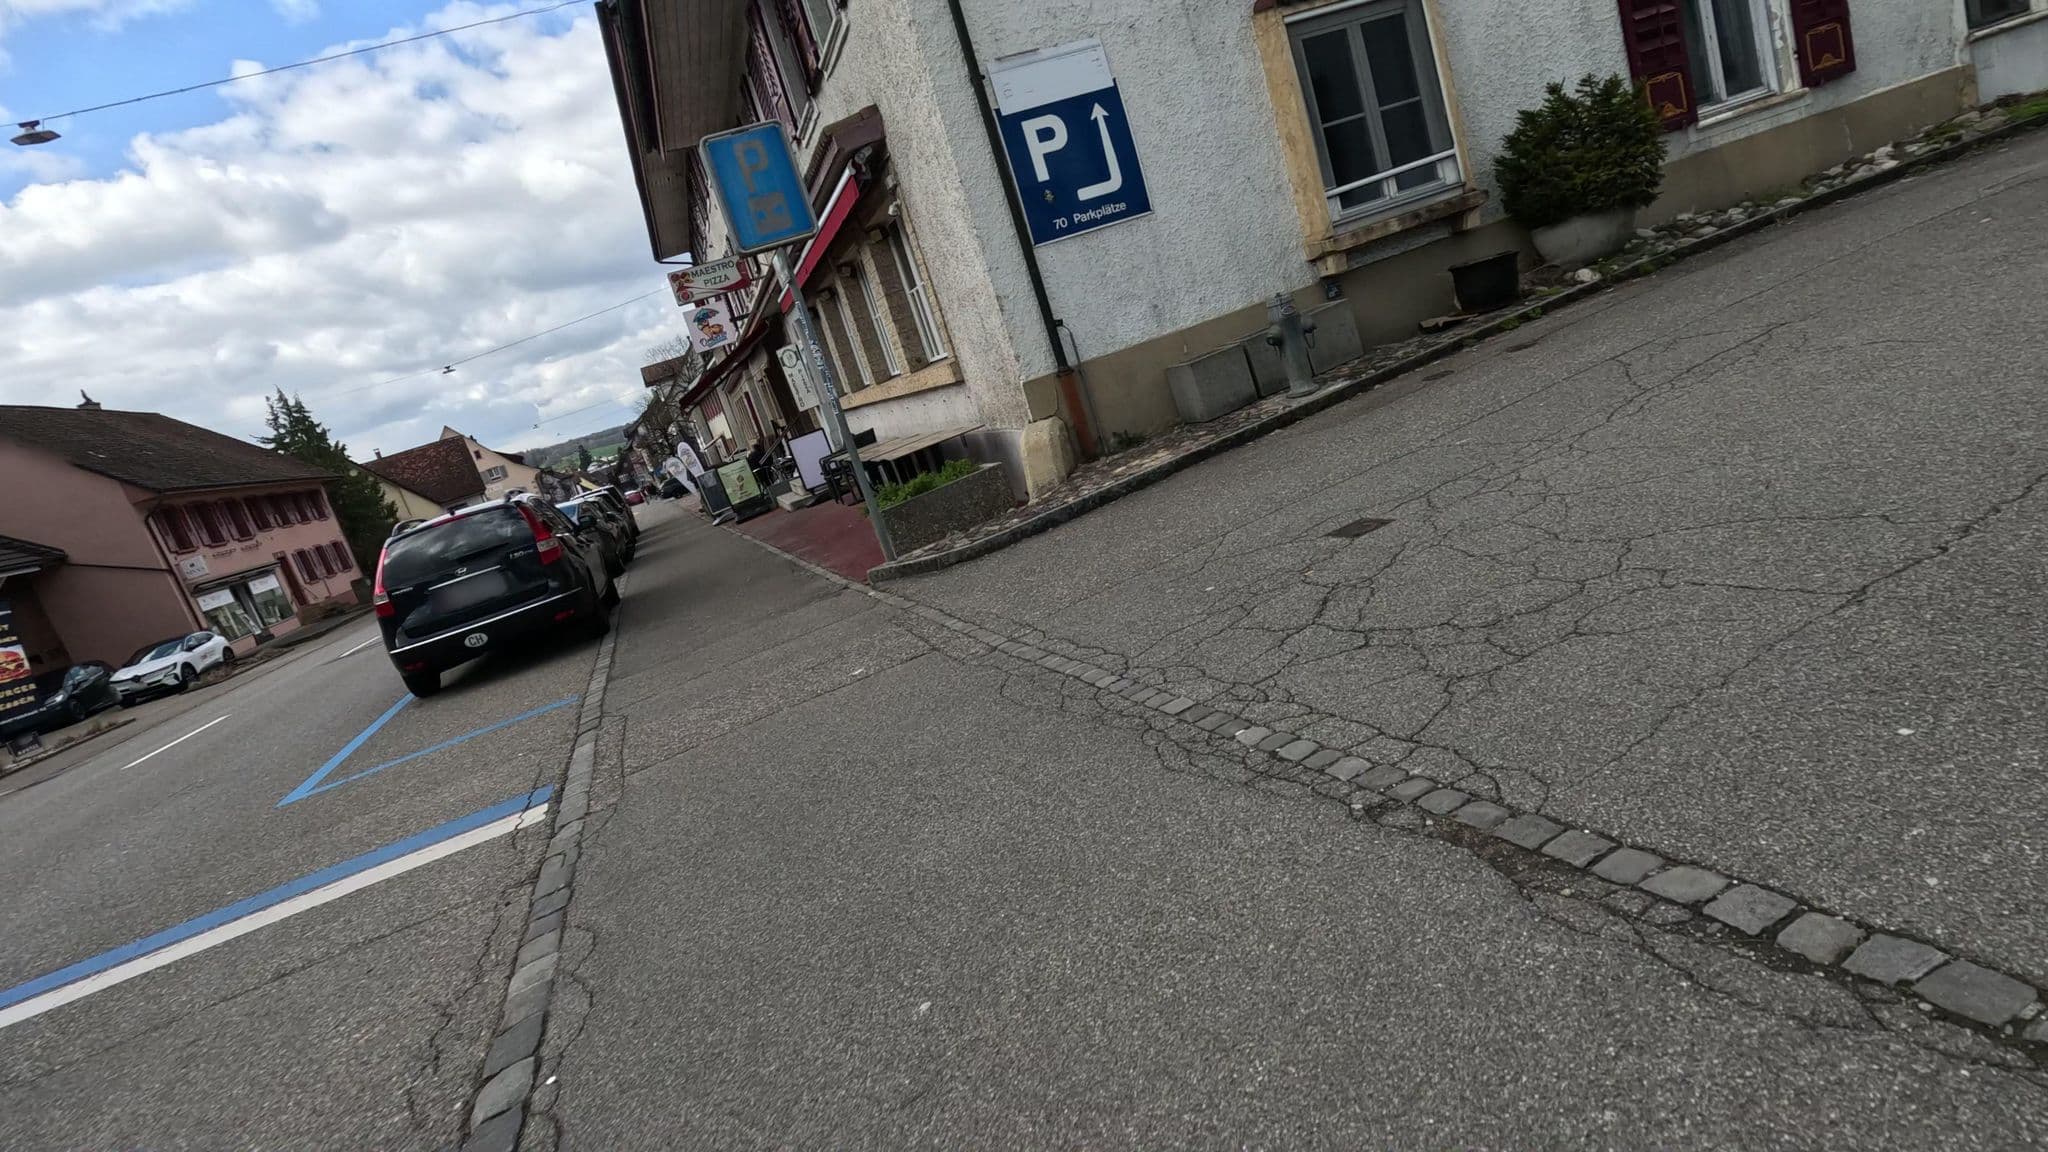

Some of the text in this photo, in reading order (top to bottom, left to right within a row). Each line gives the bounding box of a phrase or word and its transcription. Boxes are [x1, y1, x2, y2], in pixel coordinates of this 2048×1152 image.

[1021, 114, 1068, 183] P
[733, 139, 768, 192] P
[1053, 202, 1127, 229] 70 Parkplätze
[690, 260, 735, 278] MAESTRO
[703, 274, 730, 287] PIZZA
[467, 634, 484, 646] CH
